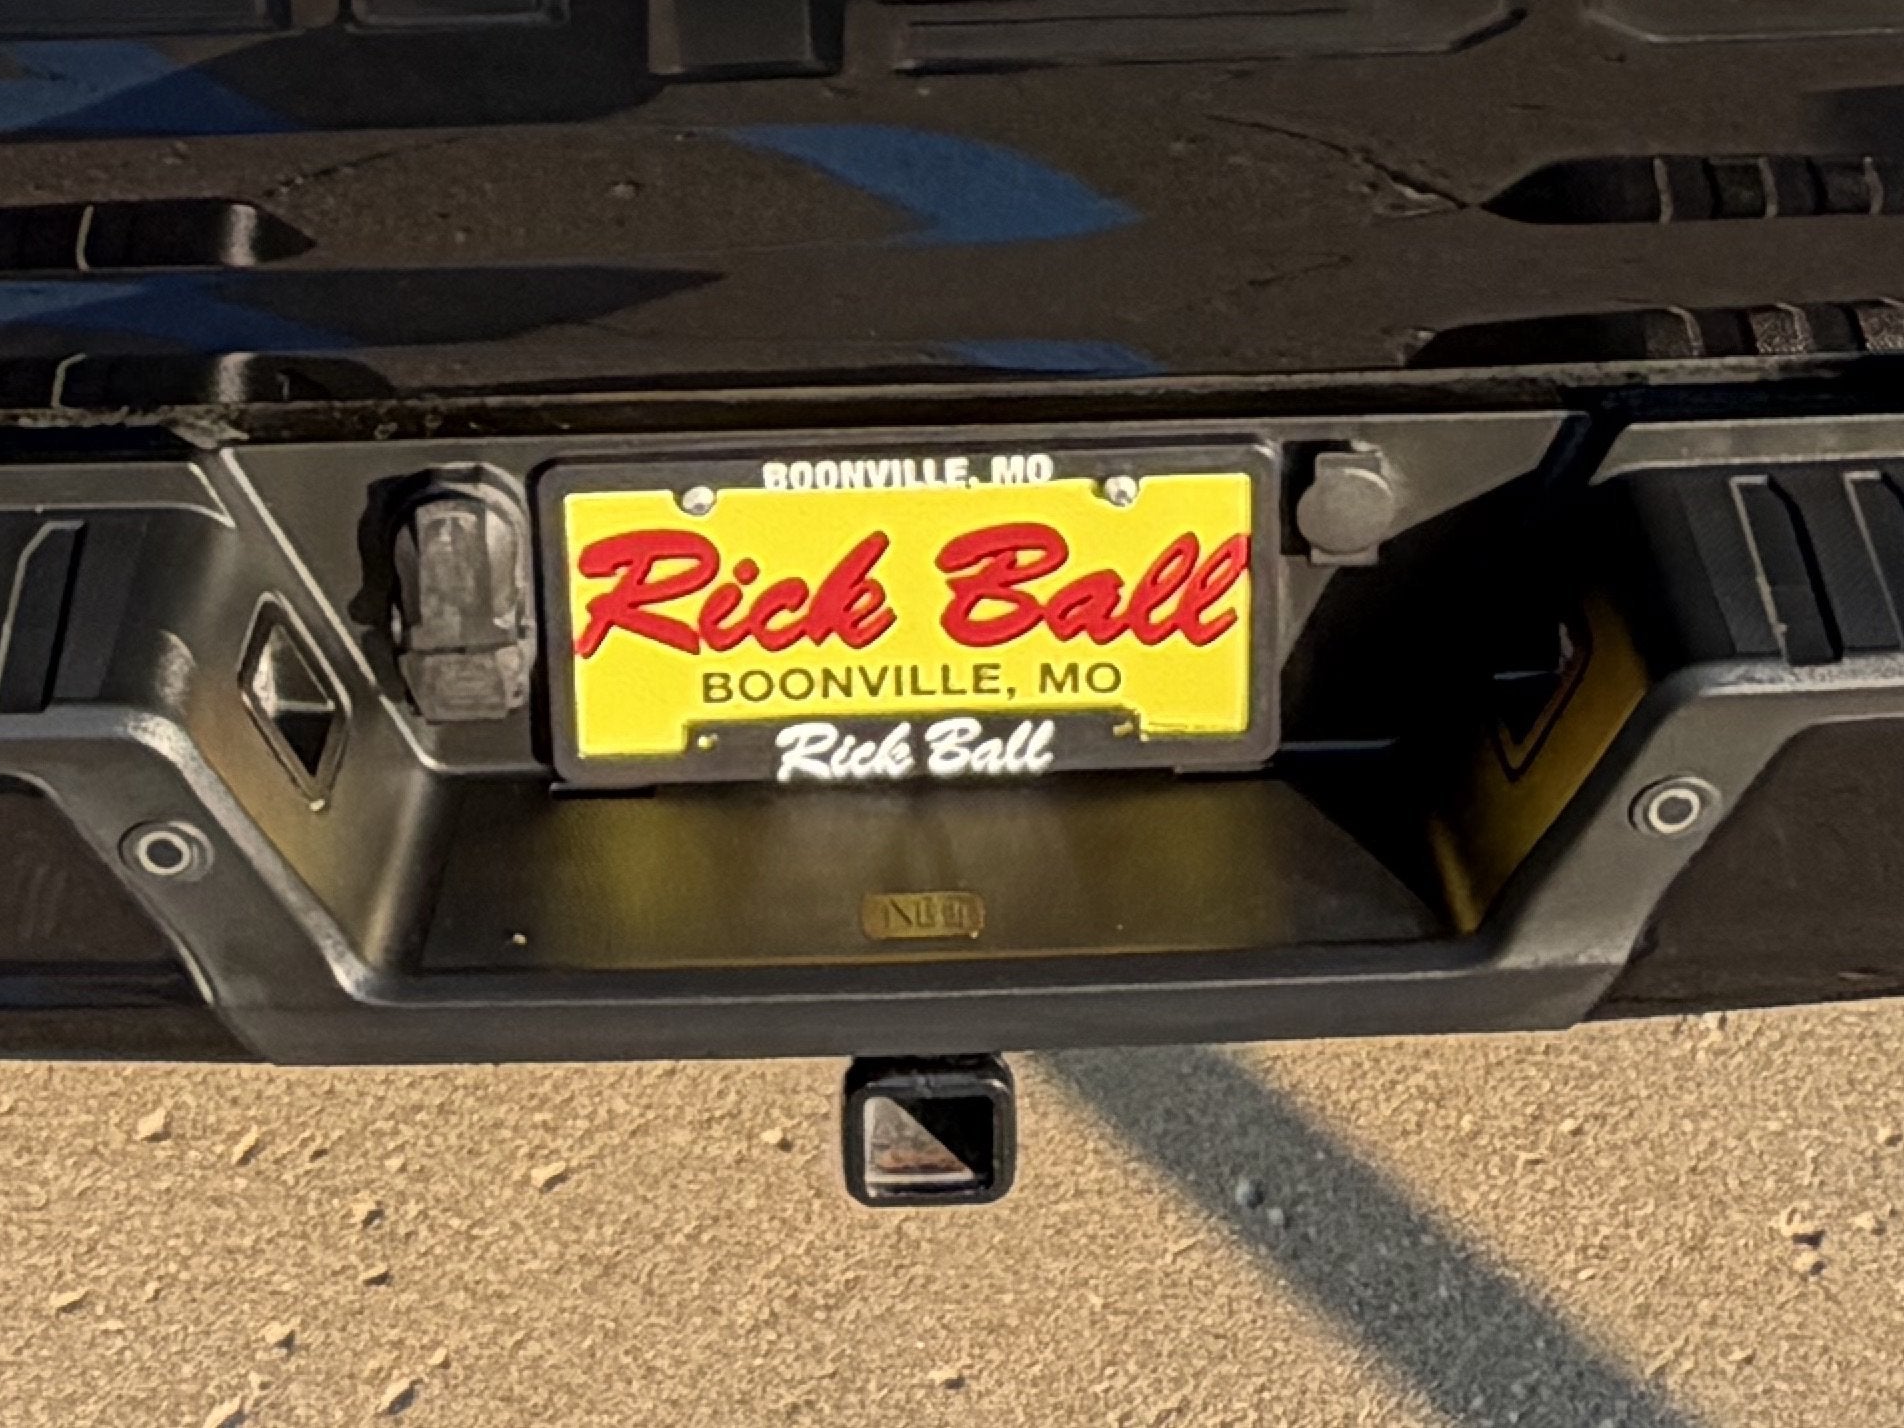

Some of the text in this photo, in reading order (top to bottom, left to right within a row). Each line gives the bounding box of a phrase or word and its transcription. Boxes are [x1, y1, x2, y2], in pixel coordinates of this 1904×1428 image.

[763, 454, 1053, 491] BOONVILLE, MO
[574, 521, 1253, 659] Rick Ball
[702, 661, 1123, 705] BOONVILLE, MO
[775, 716, 1054, 782] Rick Ball
